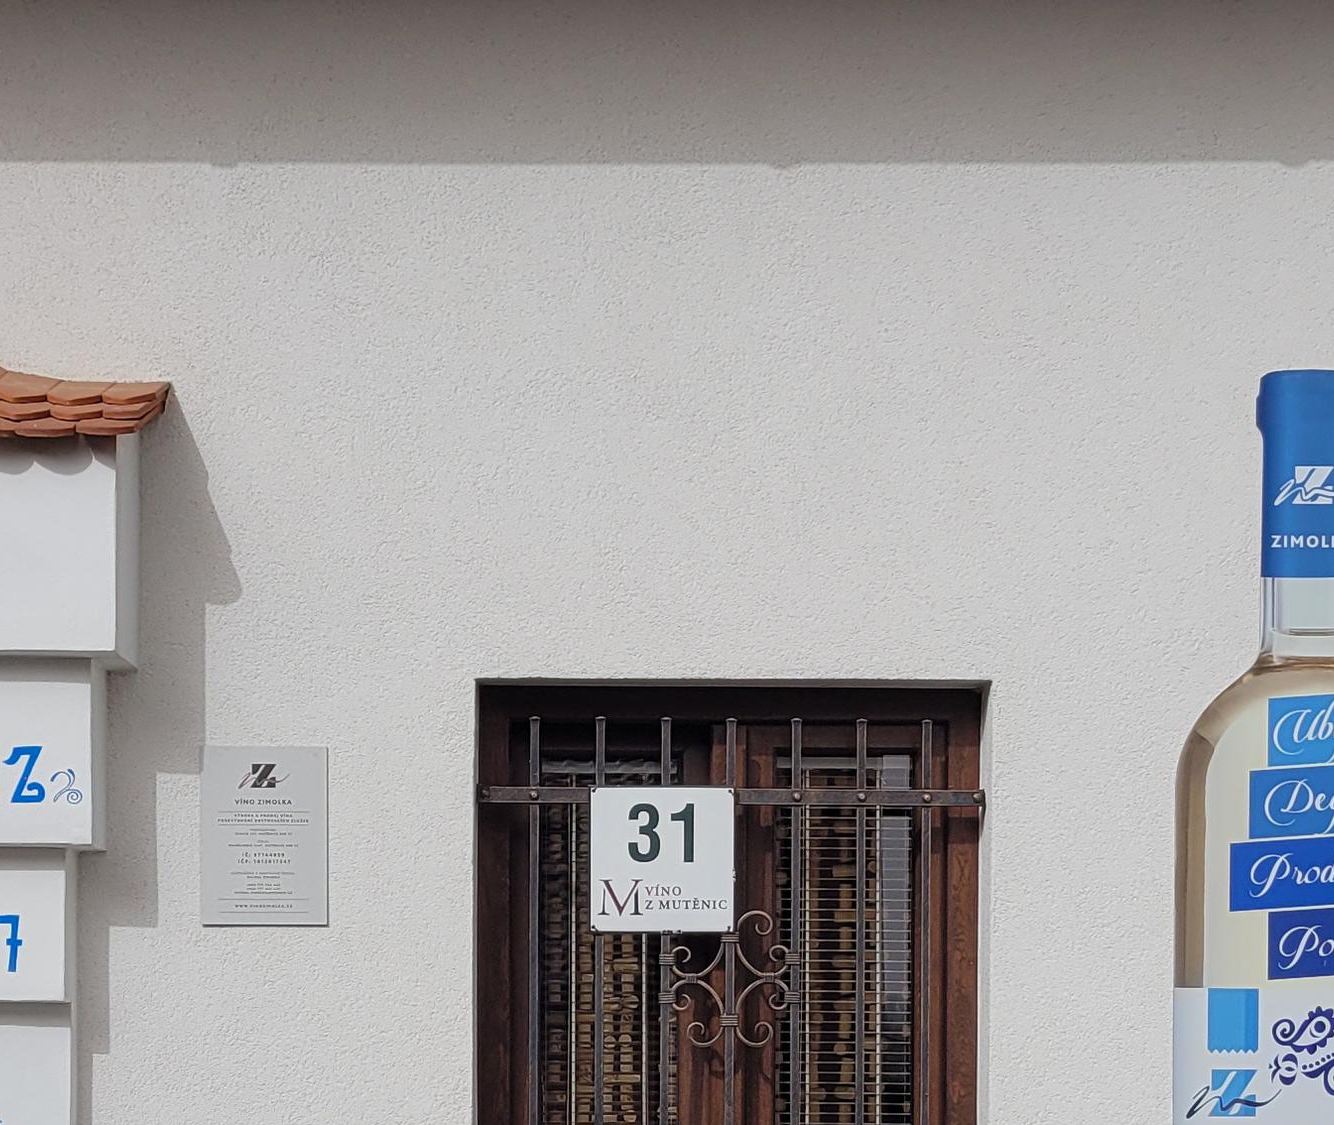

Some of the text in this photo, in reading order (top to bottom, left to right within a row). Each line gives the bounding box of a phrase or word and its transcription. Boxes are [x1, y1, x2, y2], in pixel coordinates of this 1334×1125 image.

[234, 797, 256, 806] VÍNO
[627, 802, 695, 863] 31
[644, 883, 683, 897] VÍNO
[597, 878, 644, 917] M
[644, 897, 728, 910] Z MUTĚNIC
